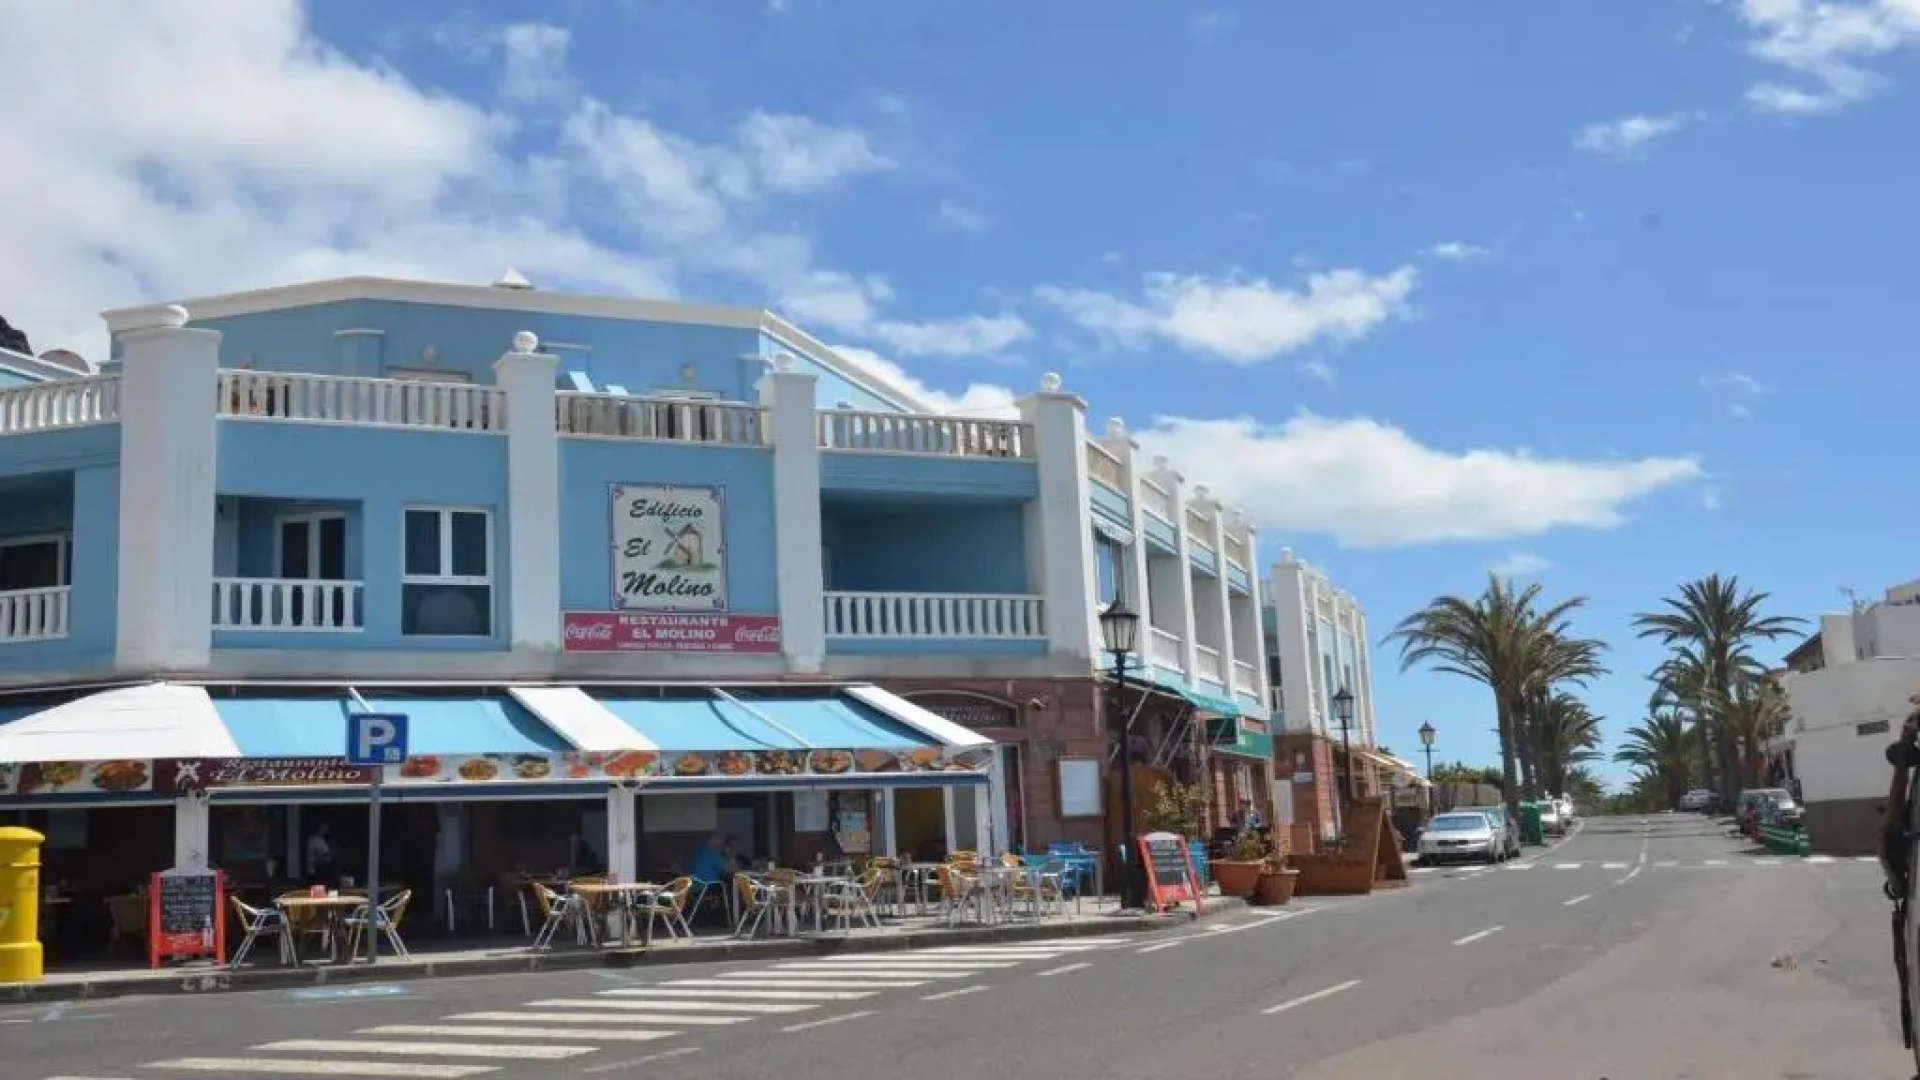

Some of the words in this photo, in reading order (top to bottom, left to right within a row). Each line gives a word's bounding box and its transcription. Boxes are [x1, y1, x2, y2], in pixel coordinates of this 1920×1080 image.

[629, 499, 703, 522] Edificio
[625, 538, 651, 557] El
[623, 571, 714, 596] Molino
[619, 614, 728, 626] RESTAURANTE
[633, 628, 652, 639] EL
[656, 628, 717, 640] MOLINO
[358, 718, 396, 758] P
[209, 767, 248, 781] El
[254, 766, 361, 780] Molino
